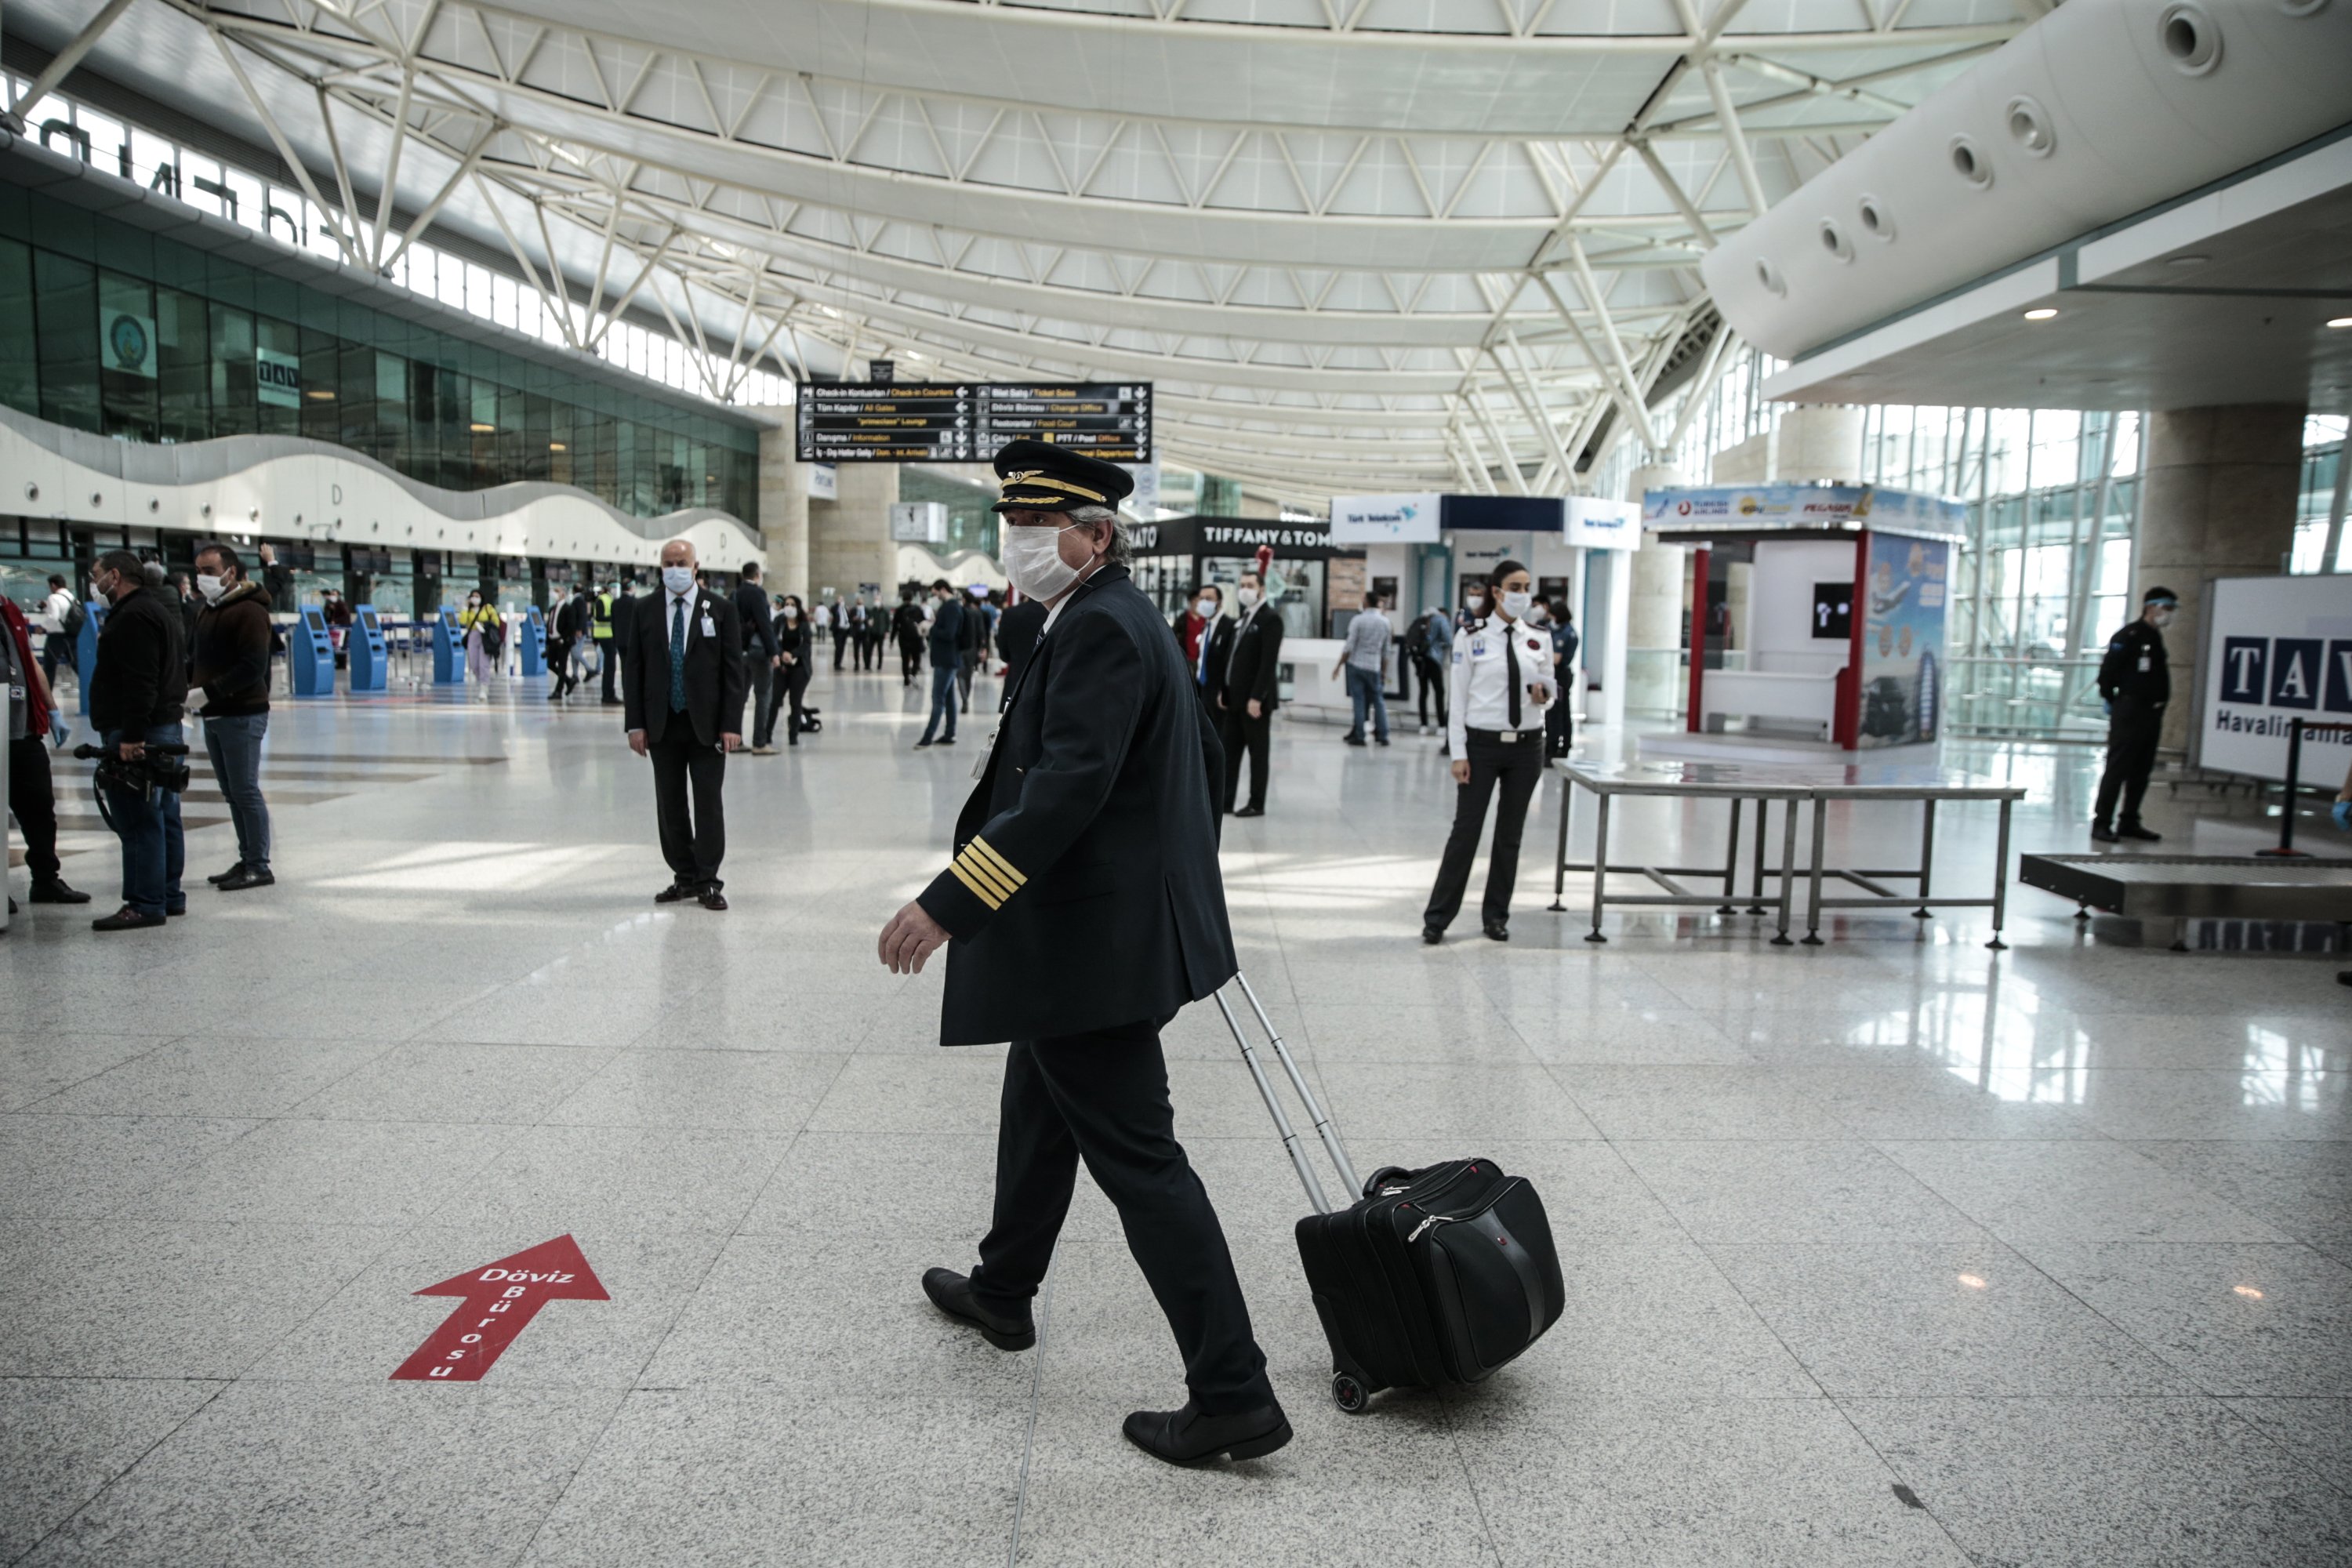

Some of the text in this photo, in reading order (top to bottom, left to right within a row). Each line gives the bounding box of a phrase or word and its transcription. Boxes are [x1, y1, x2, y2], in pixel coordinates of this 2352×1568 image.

[816, 388, 847, 397] Check-in
[891, 387, 921, 397] Check-in
[923, 387, 954, 397] Counters
[1033, 388, 1055, 397] Ticket
[1056, 389, 1076, 397] Sales
[817, 403, 833, 412] Tüm
[865, 403, 873, 412] All
[875, 403, 896, 412] Gates
[991, 402, 1014, 412] Döviz
[1015, 402, 1045, 413] Bürosu
[1050, 404, 1080, 414] Change
[1080, 403, 1103, 412] Office
[902, 418, 927, 426] Lounge
[1038, 419, 1055, 427] Food
[1057, 419, 1076, 427] Court
[852, 434, 891, 442] Information
[1056, 434, 1072, 443] PTT
[1078, 434, 1097, 443] Post
[1098, 434, 1120, 443] Office
[332, 483, 343, 506] D
[478, 1268, 576, 1284] Döviz
[429, 1285, 526, 1377] Bürosu
